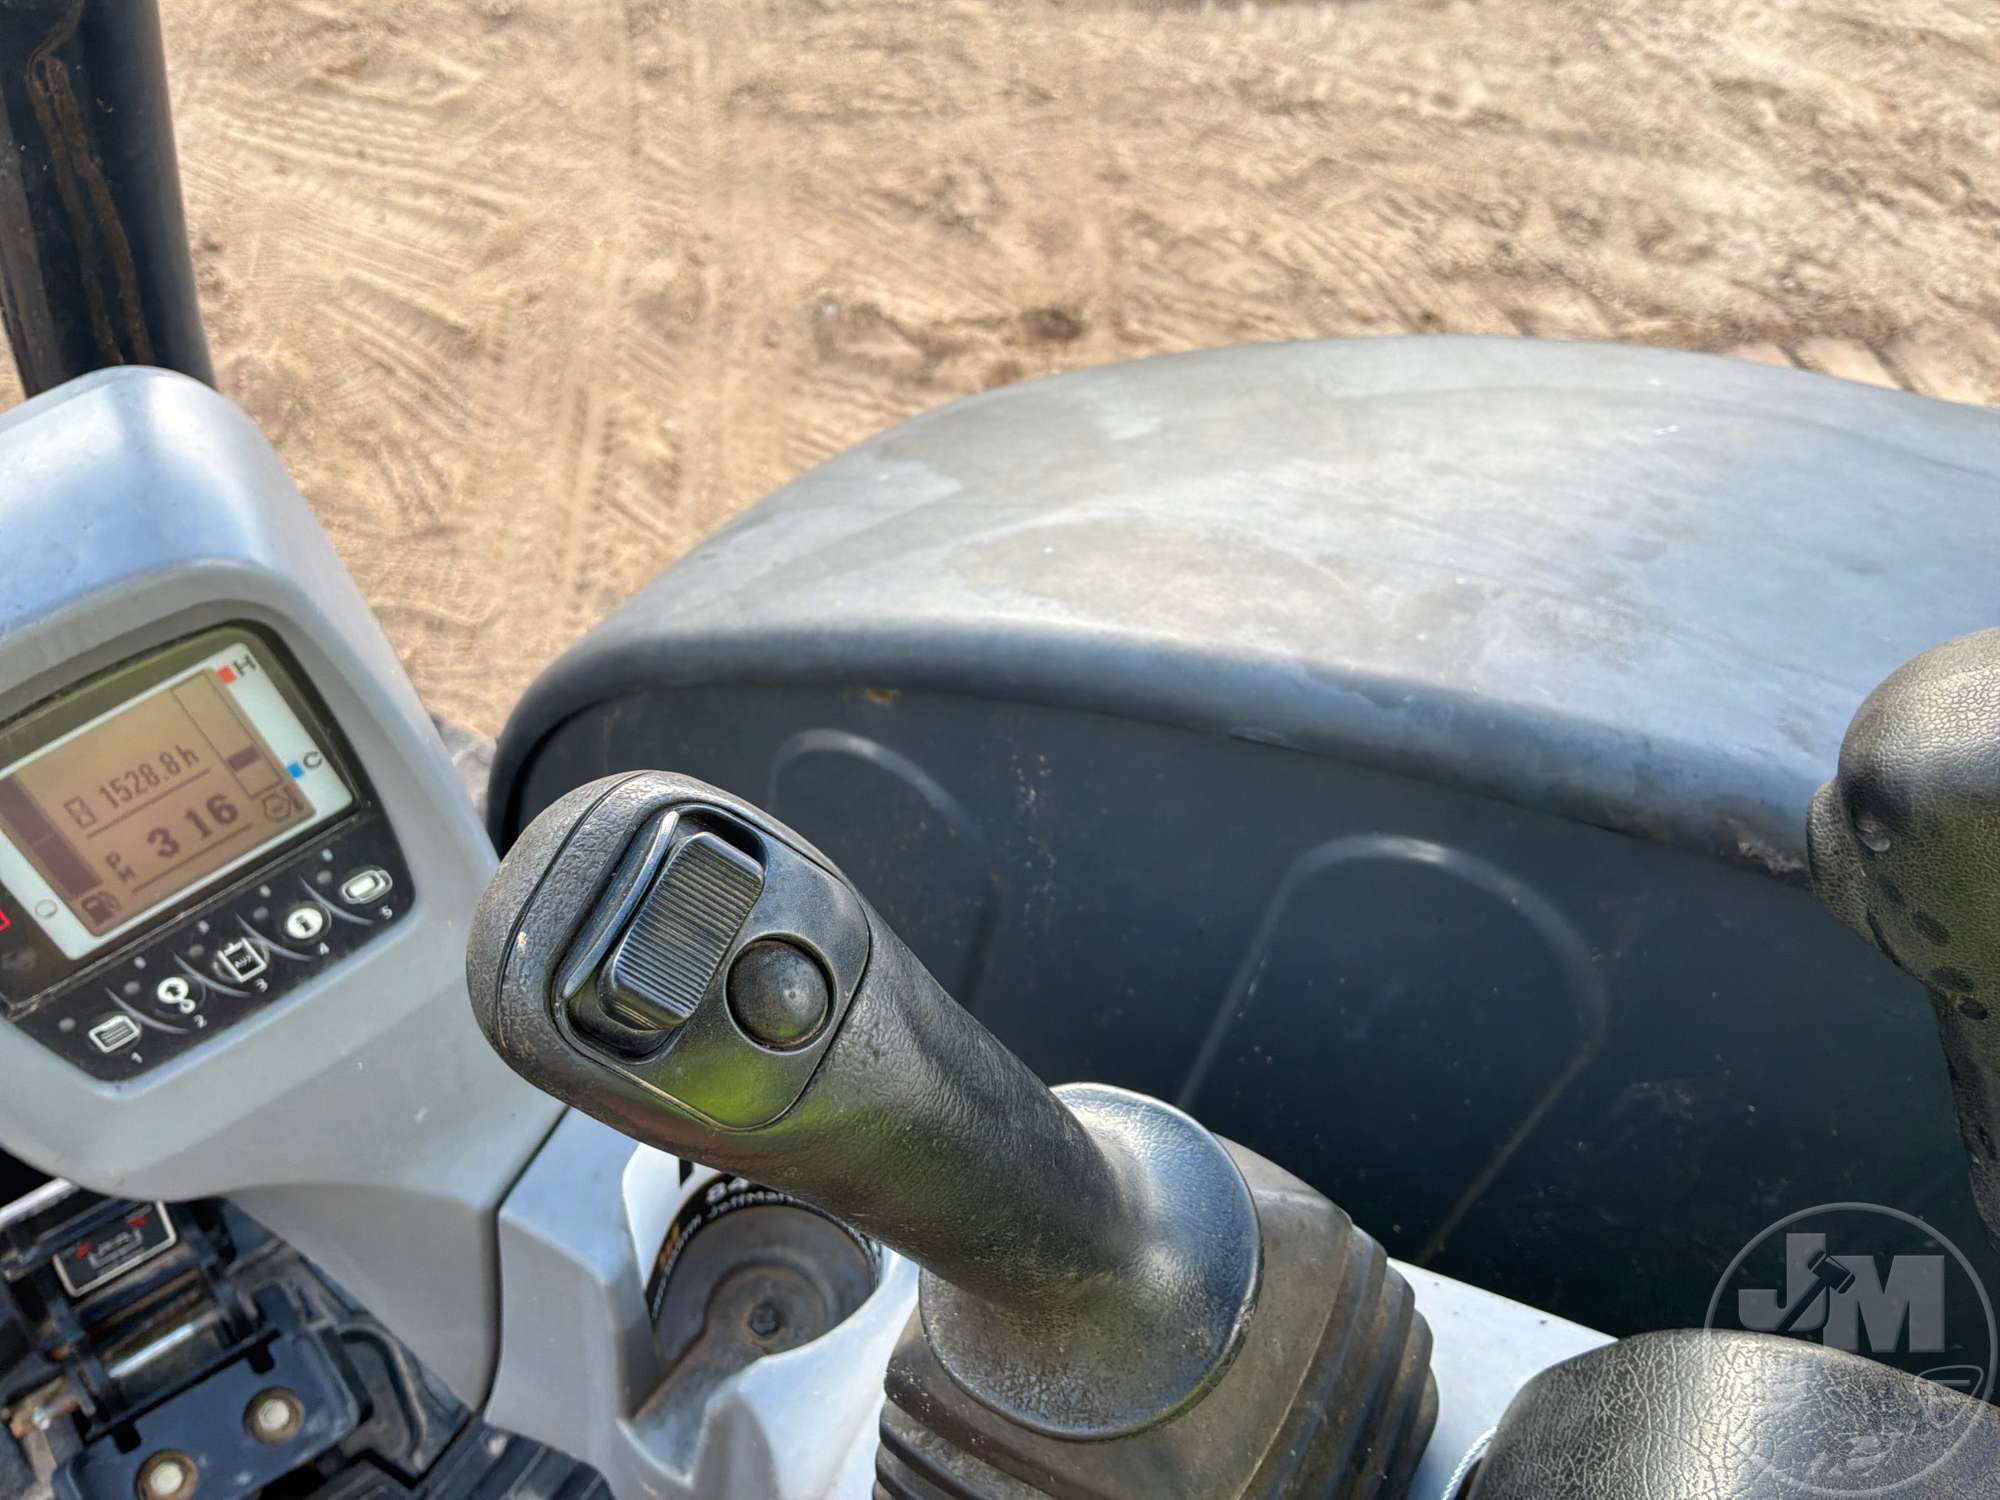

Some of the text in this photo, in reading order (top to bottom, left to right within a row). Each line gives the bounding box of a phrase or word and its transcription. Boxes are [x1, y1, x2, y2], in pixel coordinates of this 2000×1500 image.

[233, 654, 256, 677] H
[302, 750, 323, 770] C
[318, 941, 330, 956] 4
